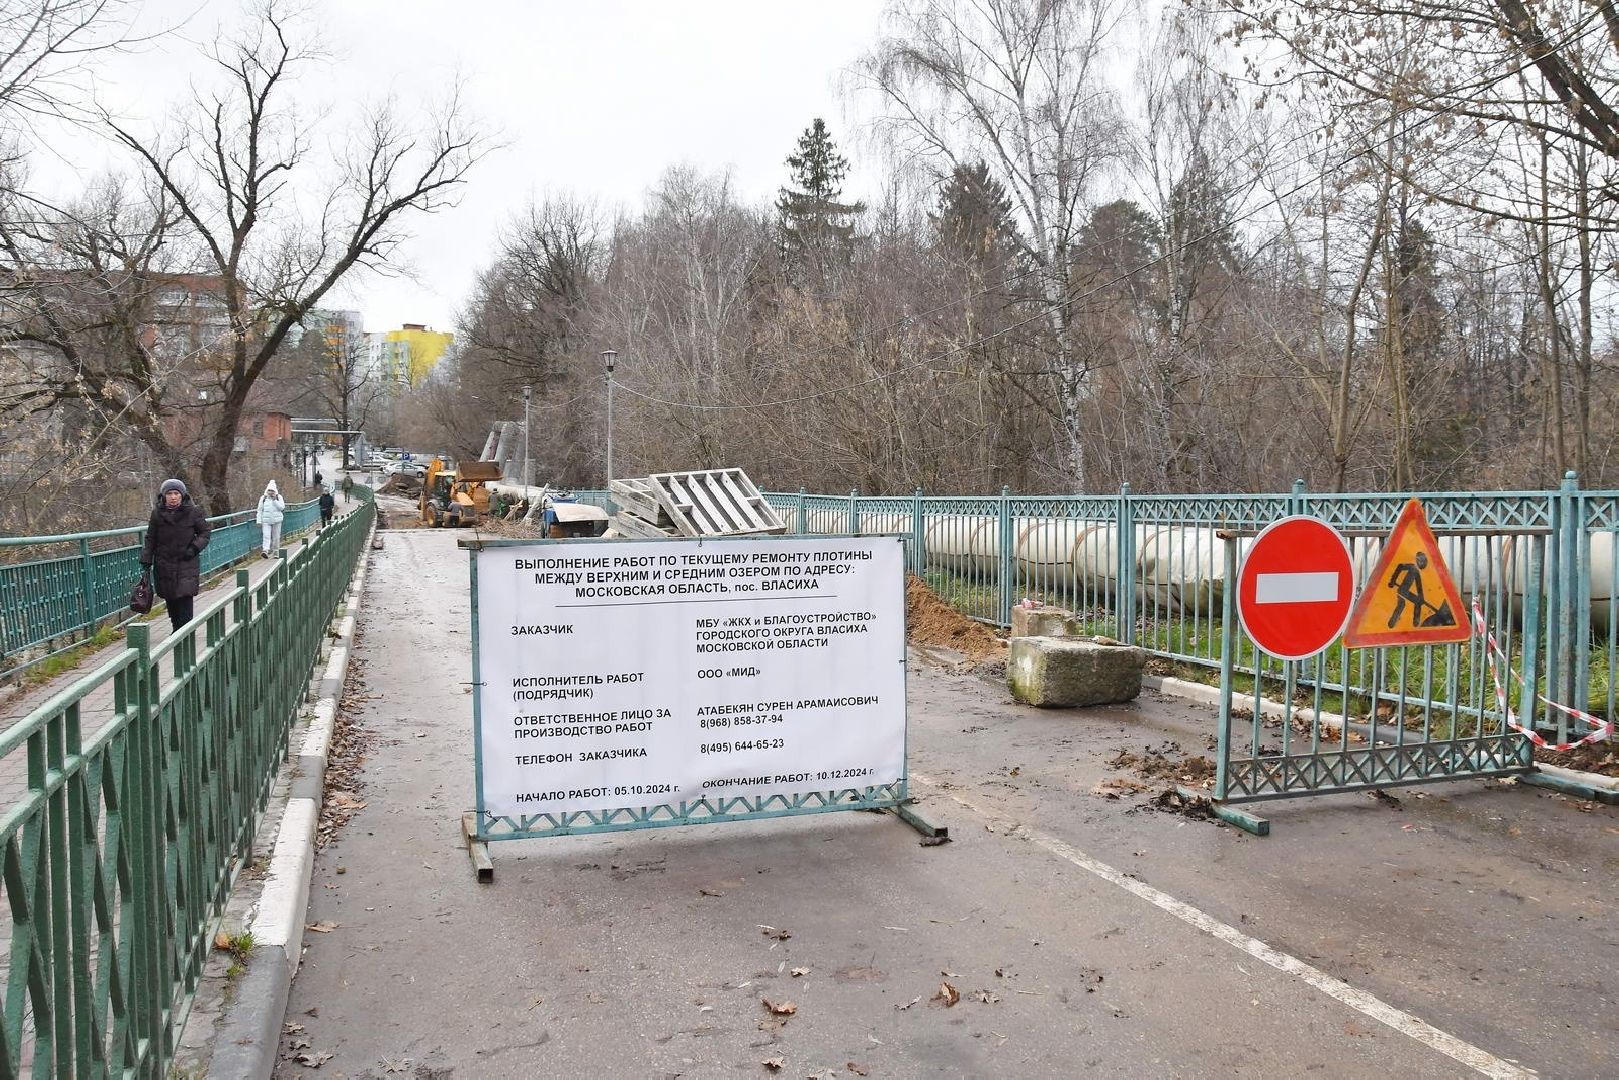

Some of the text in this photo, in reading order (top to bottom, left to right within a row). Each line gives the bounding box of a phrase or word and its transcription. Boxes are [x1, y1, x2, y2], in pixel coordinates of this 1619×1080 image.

[515, 550, 872, 572] ВЫПОЛНЕНИЕ РАБОТ ПО ТЕКУЩЕМУ РЕМОНТУ ПЛОТИНЫ
[535, 563, 855, 586] МЕЖДУ ВЕРХНИМ И СРЕДНИМ ОЗЕРОМ ПО АДРЕСУ:
[575, 577, 819, 598] МОСКОВСКАЯ ОБЛАСТЬ, пос. ВЛАСИХА
[696, 611, 877, 630] МБУ «ЖКХ и БЛАГОУСТРОЙСТВО»
[511, 624, 573, 636] ЗАКАЗЧИК
[696, 624, 868, 641] ГОРОДСКОГО ОКРУГА ВЛАСИХА
[696, 638, 828, 653] МОСКОВСКОЙ ОБЛАСТИ
[513, 672, 644, 688] ИСПОЛНИТЕЛЬ РАБОТ
[697, 666, 761, 679] ООО «МИД»
[513, 687, 594, 703] (ПОДРЯДЧИК)
[697, 695, 879, 716] АТАБЕКЯН СУРЕН АРАМАИСОВИЧ
[514, 708, 672, 725] ОТВЕТСТВЕННОЕ ЛИЦО ЗА
[700, 713, 783, 730] 8(968) 858-37-94
[514, 721, 653, 739] ПРОИЗВОДСТВО РАБОТ
[700, 738, 784, 755] 8(495) 644-65-23
[515, 748, 648, 765] ТЕЛЕФОН ЗАКАЗЧИКА
[702, 776, 772, 789] ОКОНЧАНИЕ
[774, 772, 813, 784] РАБОТ:
[814, 768, 867, 780] 10.12.2024
[516, 790, 566, 803] НАЧАЛО
[568, 787, 613, 799] РАБОТ:
[614, 784, 671, 796] 05.10.2024
